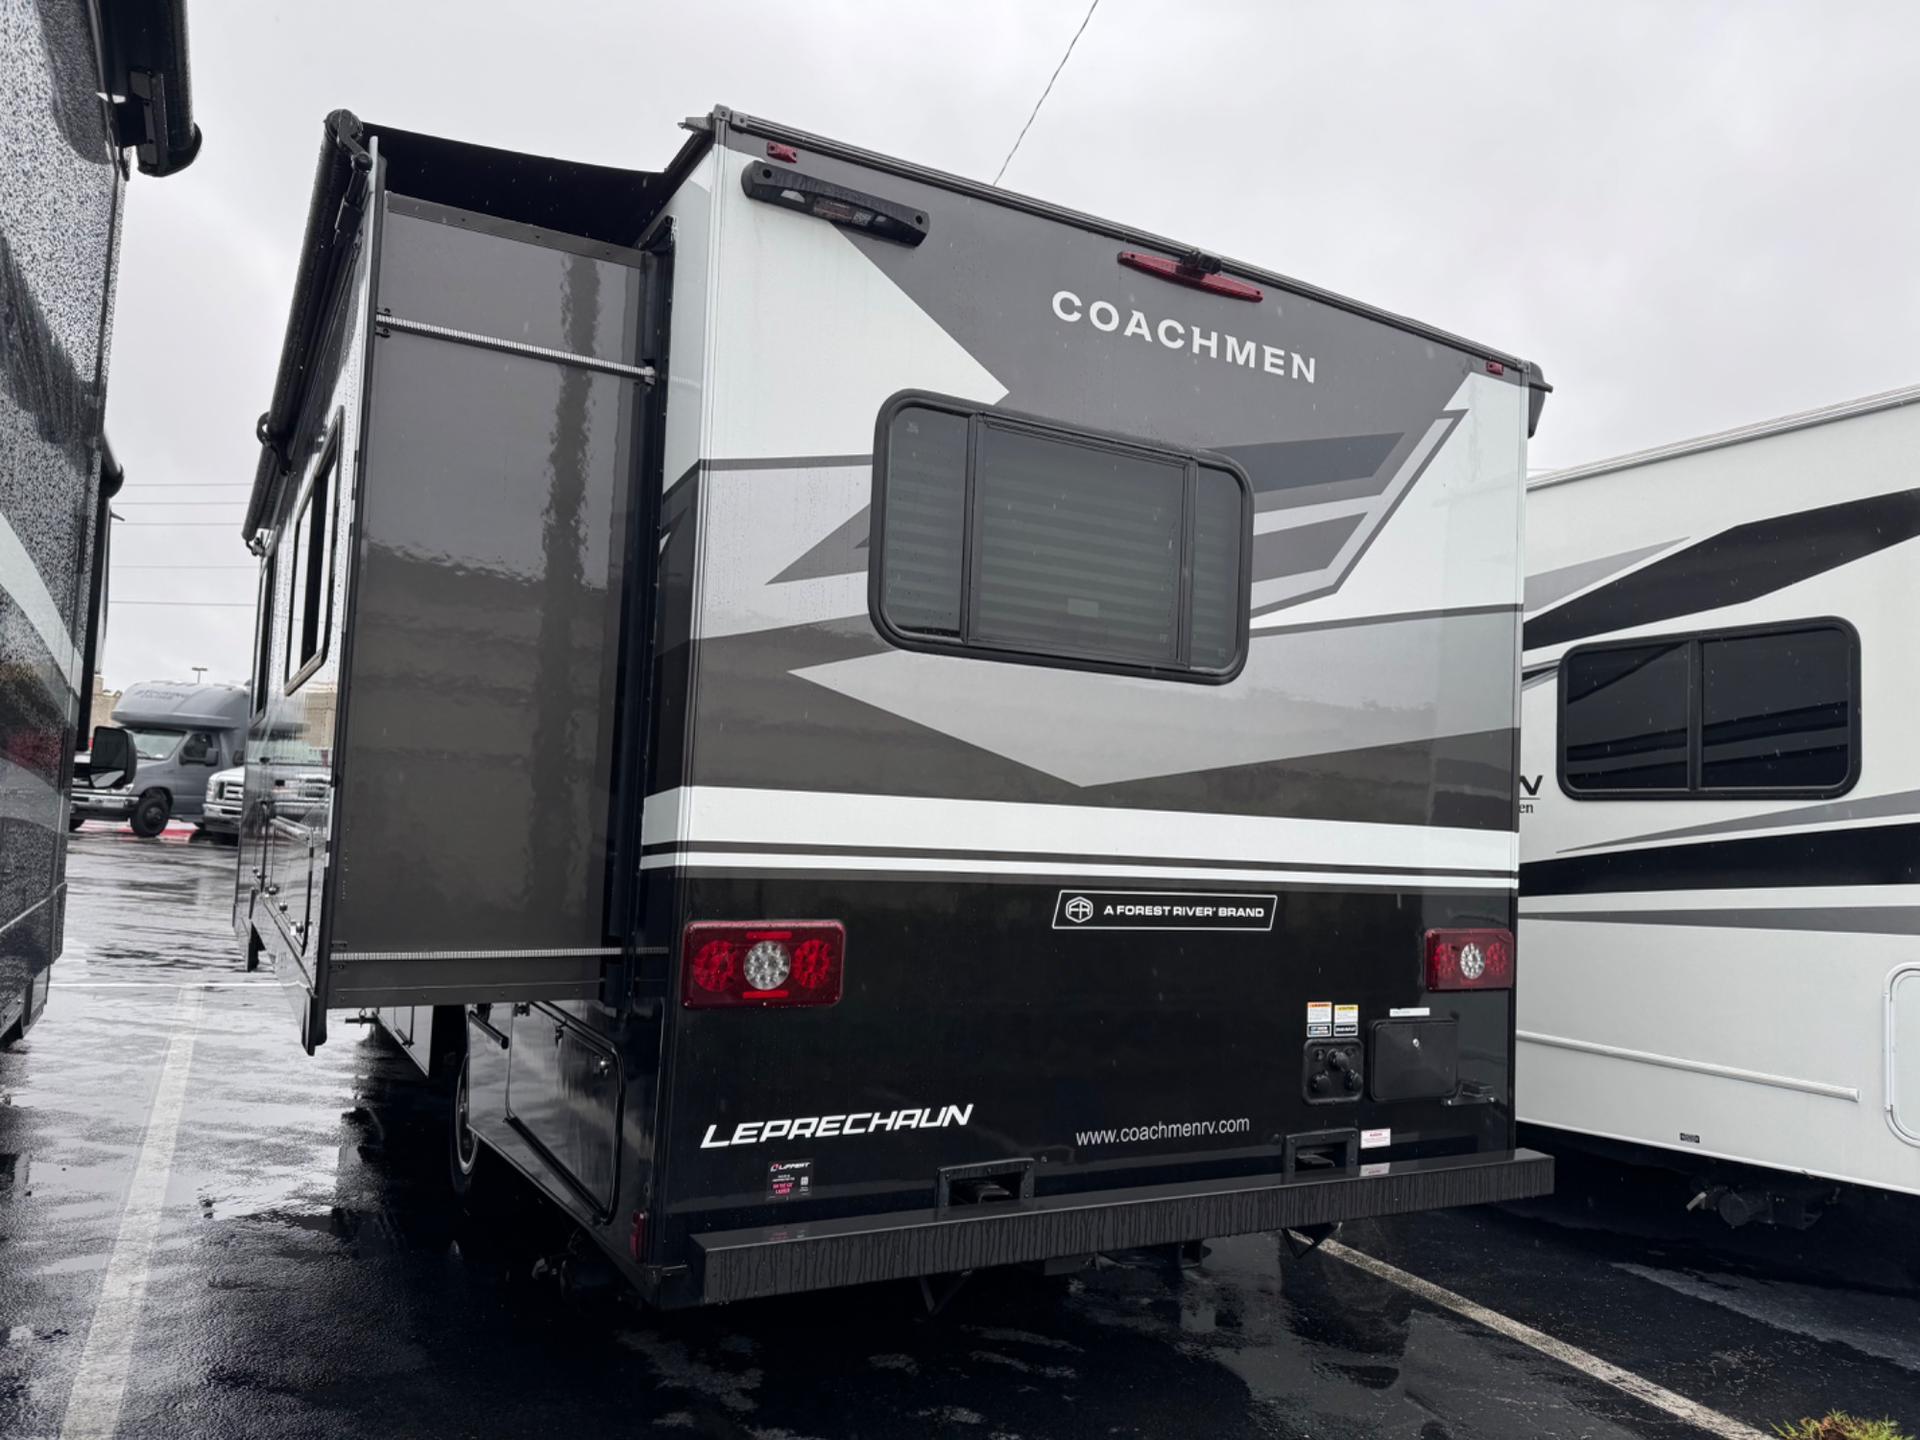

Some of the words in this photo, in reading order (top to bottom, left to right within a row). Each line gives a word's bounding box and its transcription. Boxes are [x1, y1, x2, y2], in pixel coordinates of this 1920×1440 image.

[1052, 290, 1316, 384] COACHMEN
[1104, 905, 1114, 916] A
[1116, 905, 1171, 917] FOREST
[1218, 907, 1264, 918] BRAND
[700, 1103, 974, 1149] LEPRECHAUN
[1076, 1117, 1250, 1146] www.coachmenrv.com
